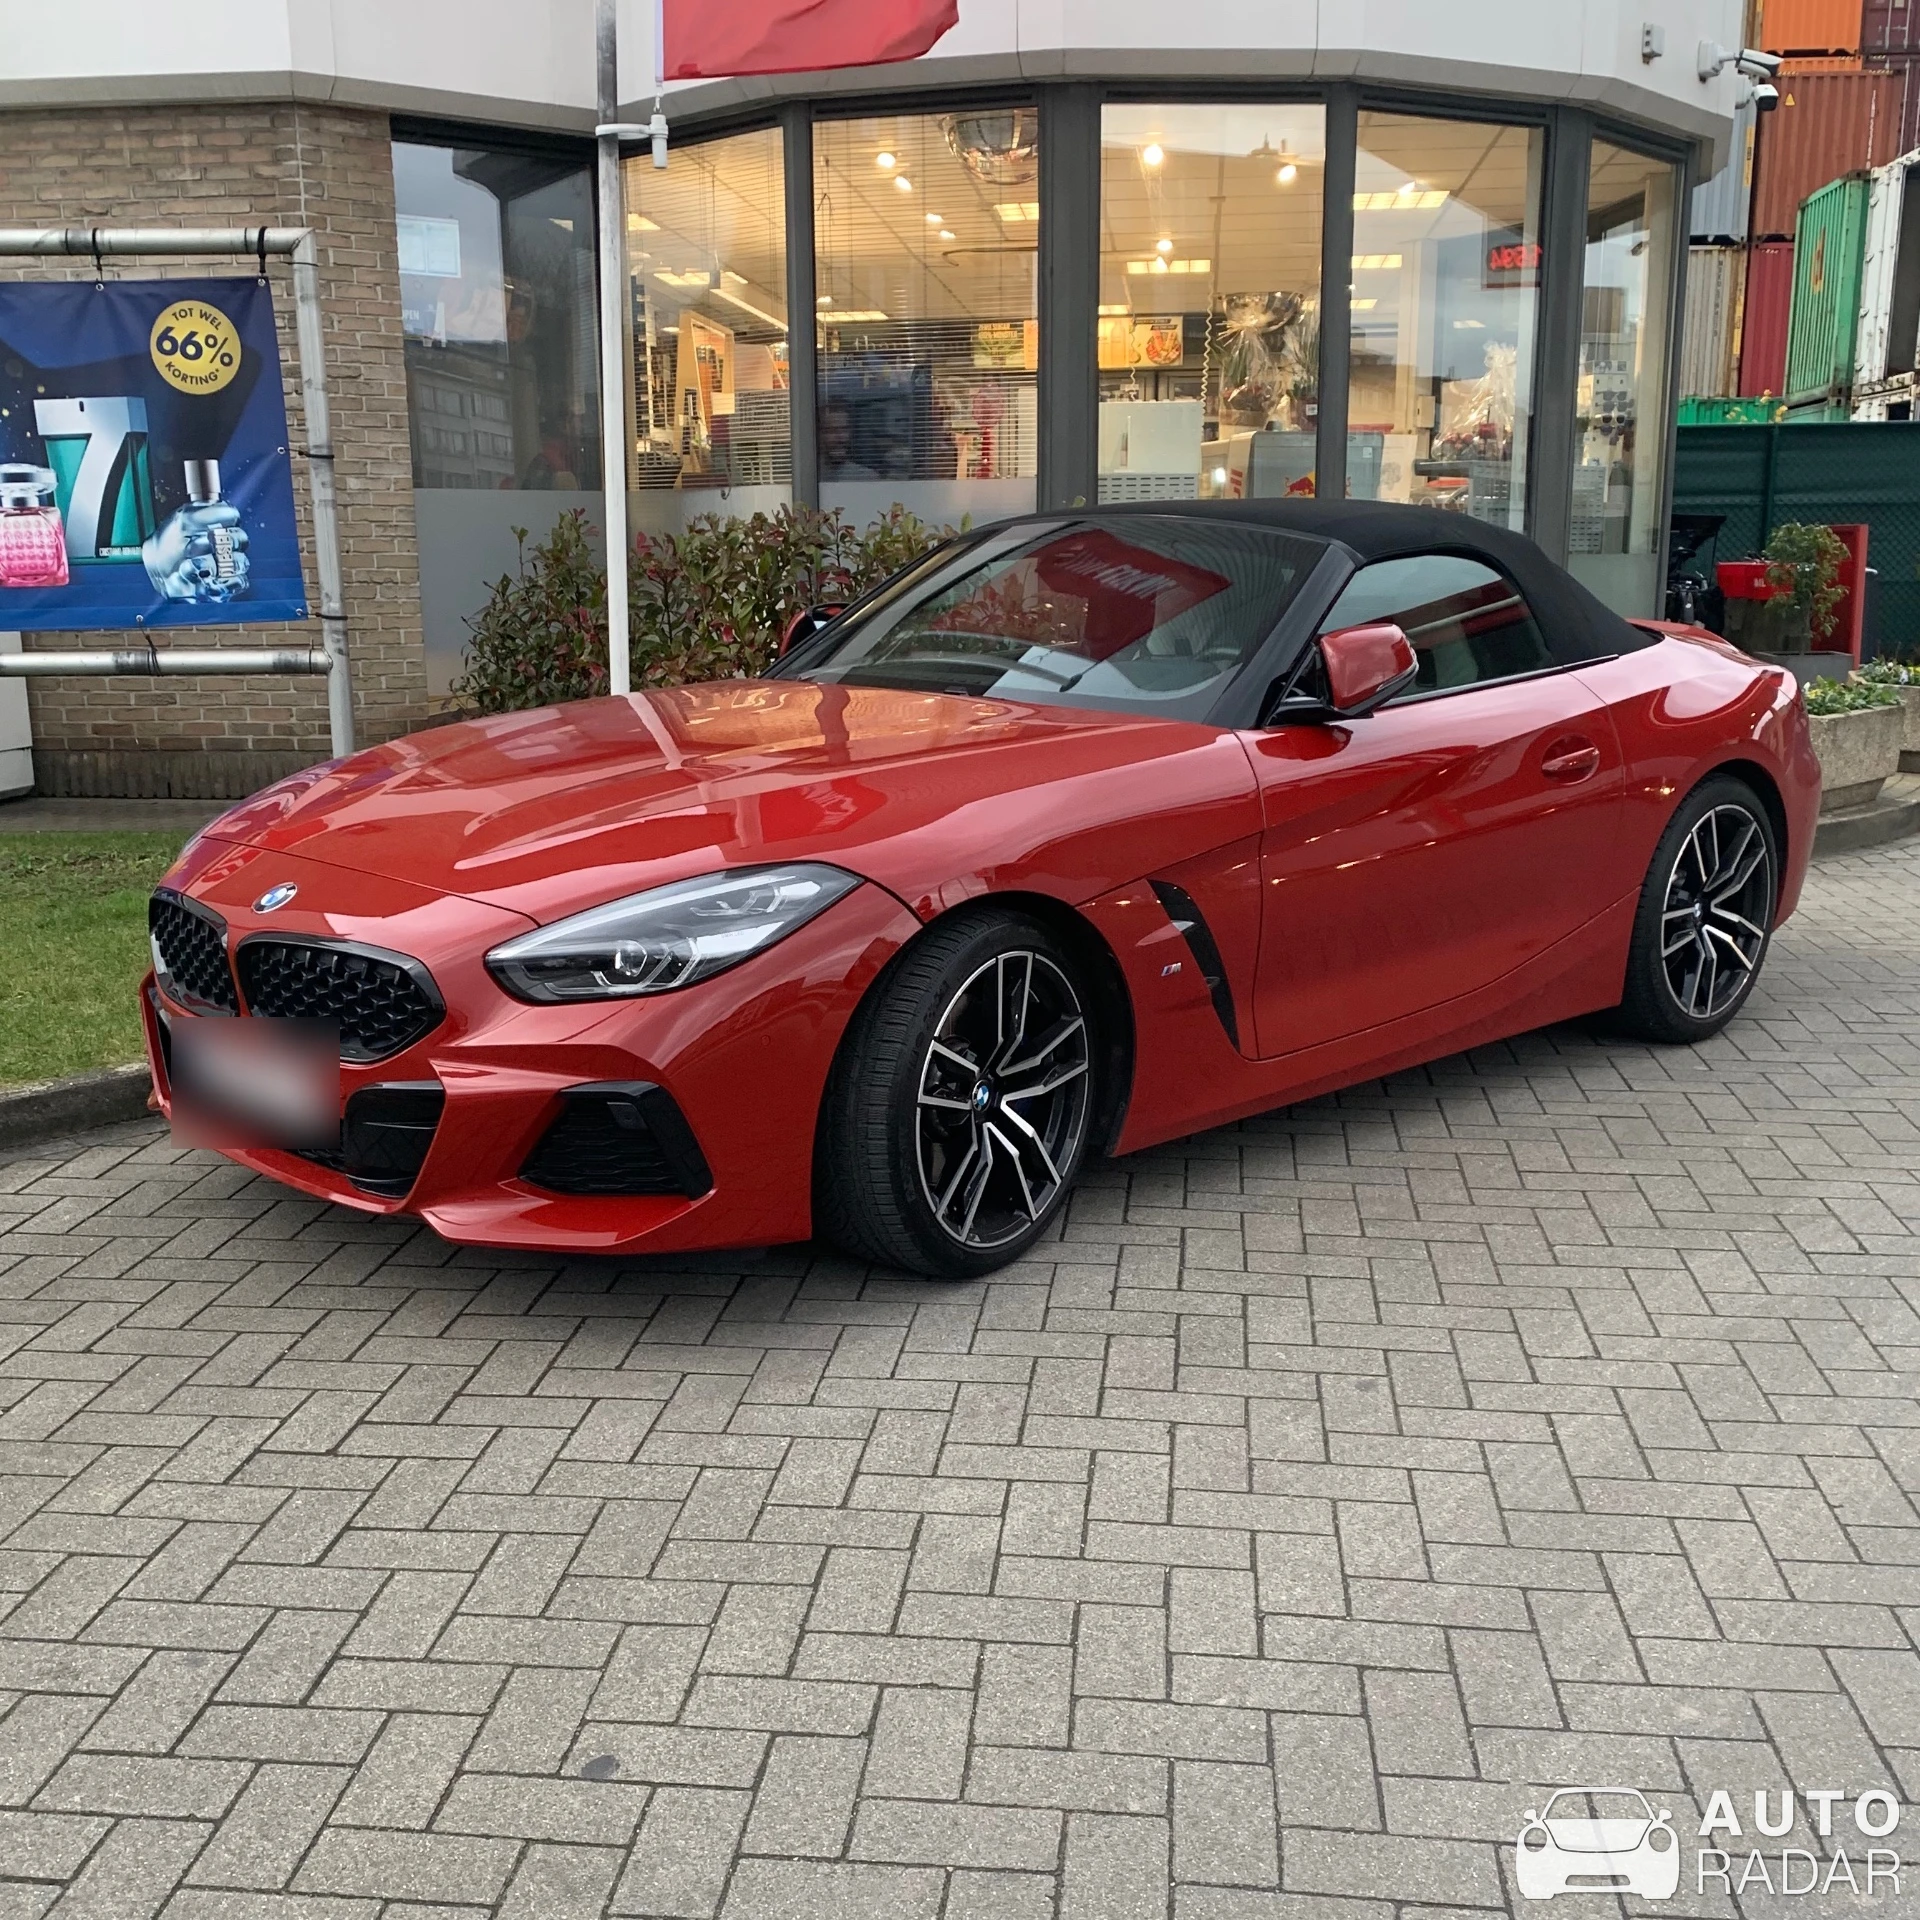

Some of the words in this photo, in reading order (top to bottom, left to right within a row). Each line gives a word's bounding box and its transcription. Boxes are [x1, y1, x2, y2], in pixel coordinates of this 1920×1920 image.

[172, 308, 194, 321] TOT
[200, 309, 222, 330] WEL
[156, 326, 233, 367] 66%
